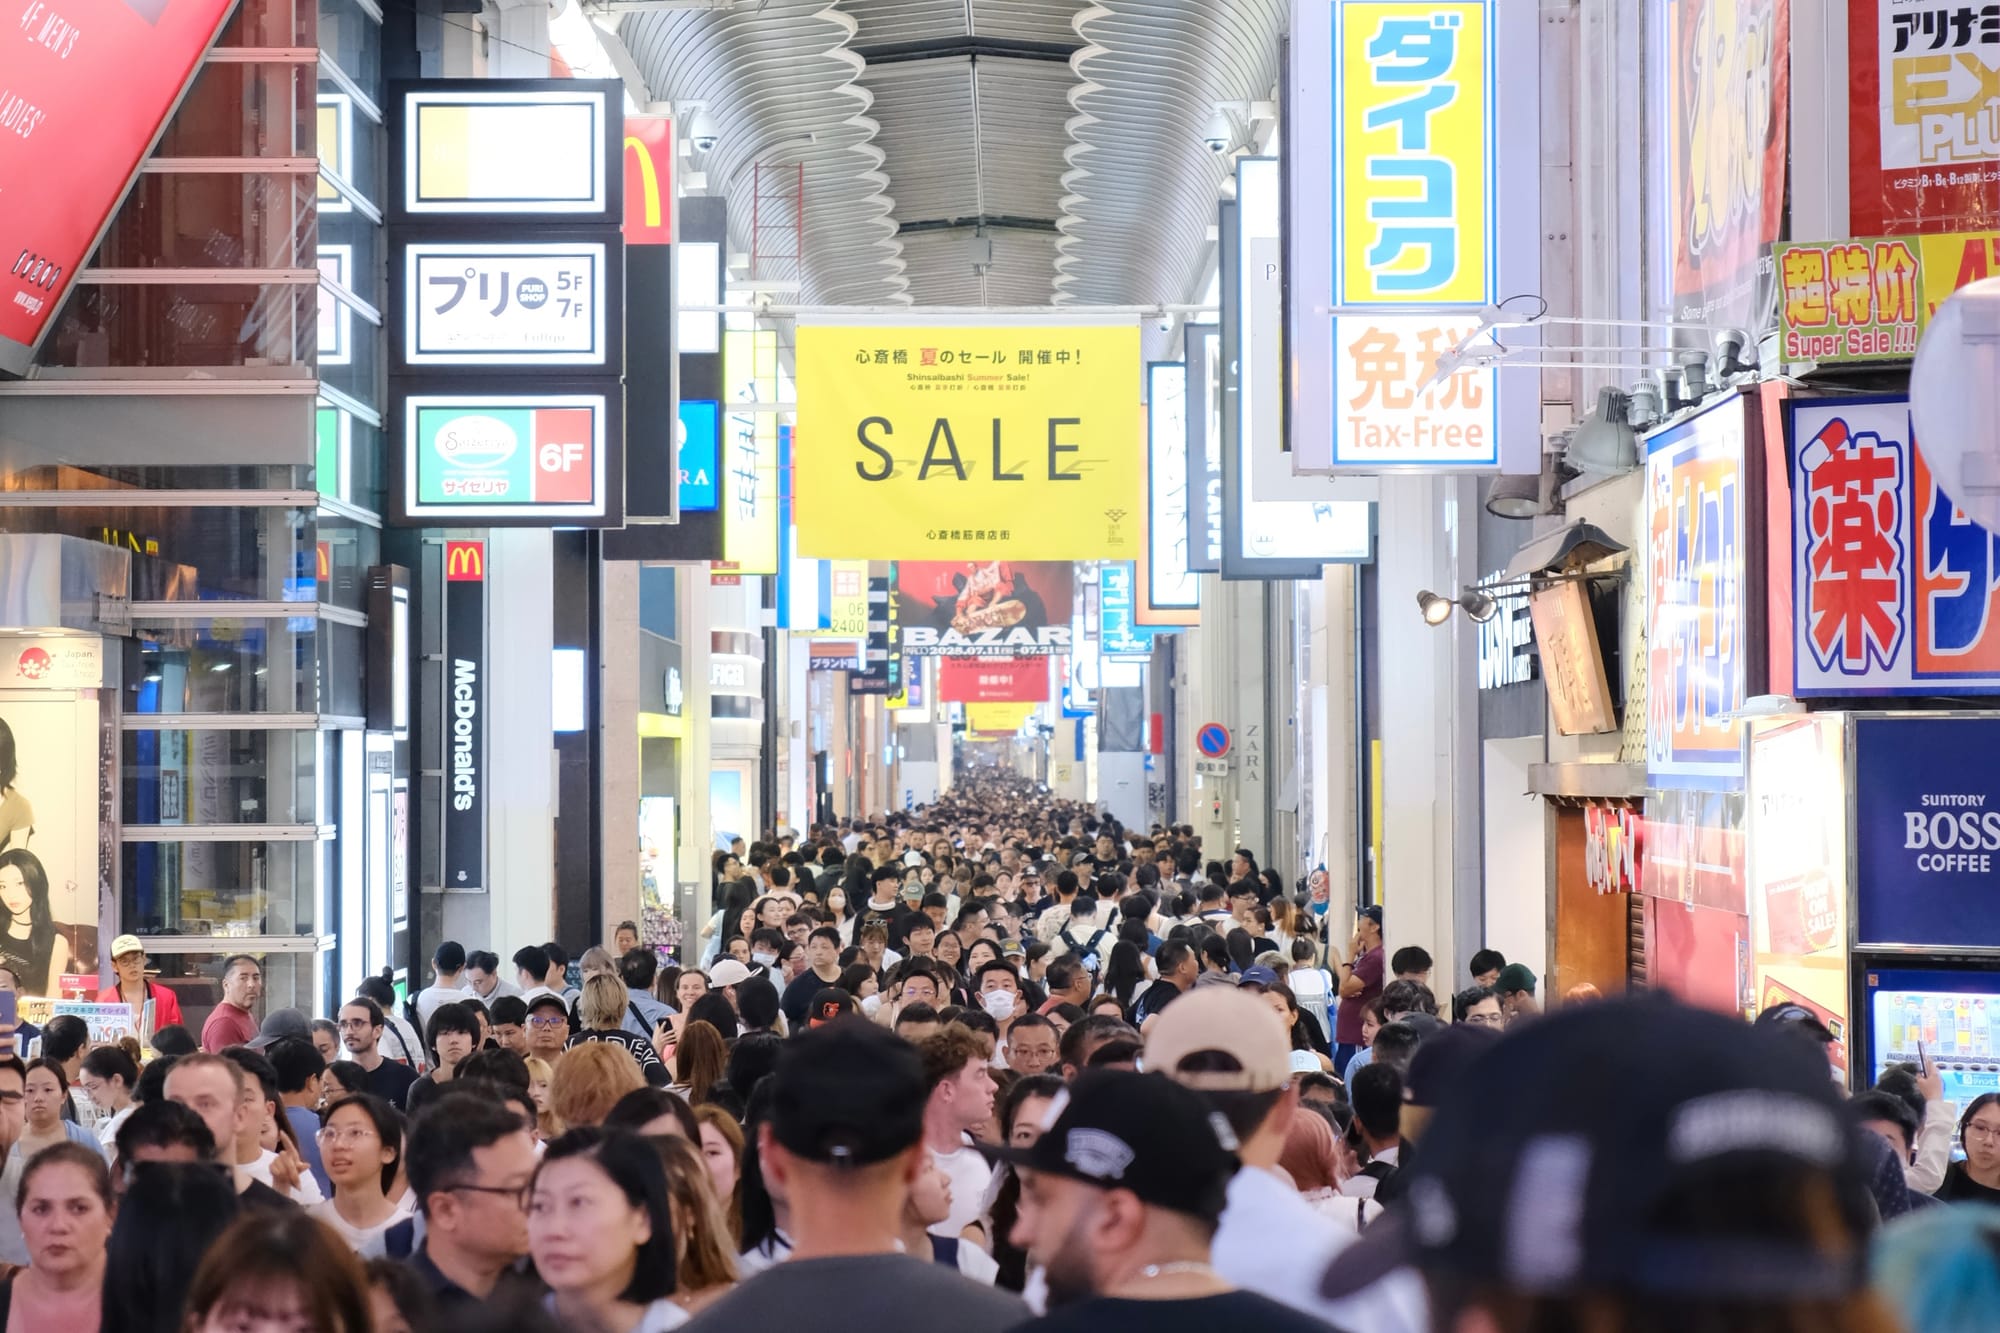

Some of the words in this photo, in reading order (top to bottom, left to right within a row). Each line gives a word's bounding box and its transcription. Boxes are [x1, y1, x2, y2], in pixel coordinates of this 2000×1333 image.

[1368, 14, 1461, 291] ダイコク
[429, 267, 510, 318] プリ
[557, 271, 583, 291] 5F
[1782, 244, 1918, 327] 超特价
[557, 298, 583, 318] 7F
[919, 347, 1007, 367] 夏のセール
[1787, 331, 1843, 360] Super
[1847, 327, 1890, 354] Sale
[907, 373, 965, 382] Shinsaibashi
[967, 374, 1003, 382] Summer
[1348, 326, 1483, 411] 免税
[855, 415, 1082, 482] SALE
[1347, 416, 1484, 448] Tax-Free
[539, 443, 585, 473] 6F
[1811, 446, 1897, 661] 薬
[902, 627, 1072, 646] BAZAR
[454, 659, 476, 811] McDonald's
[1246, 725, 1260, 782] ZARA
[1903, 811, 2000, 851] BOSS
[1917, 853, 1991, 872] COFFEE
